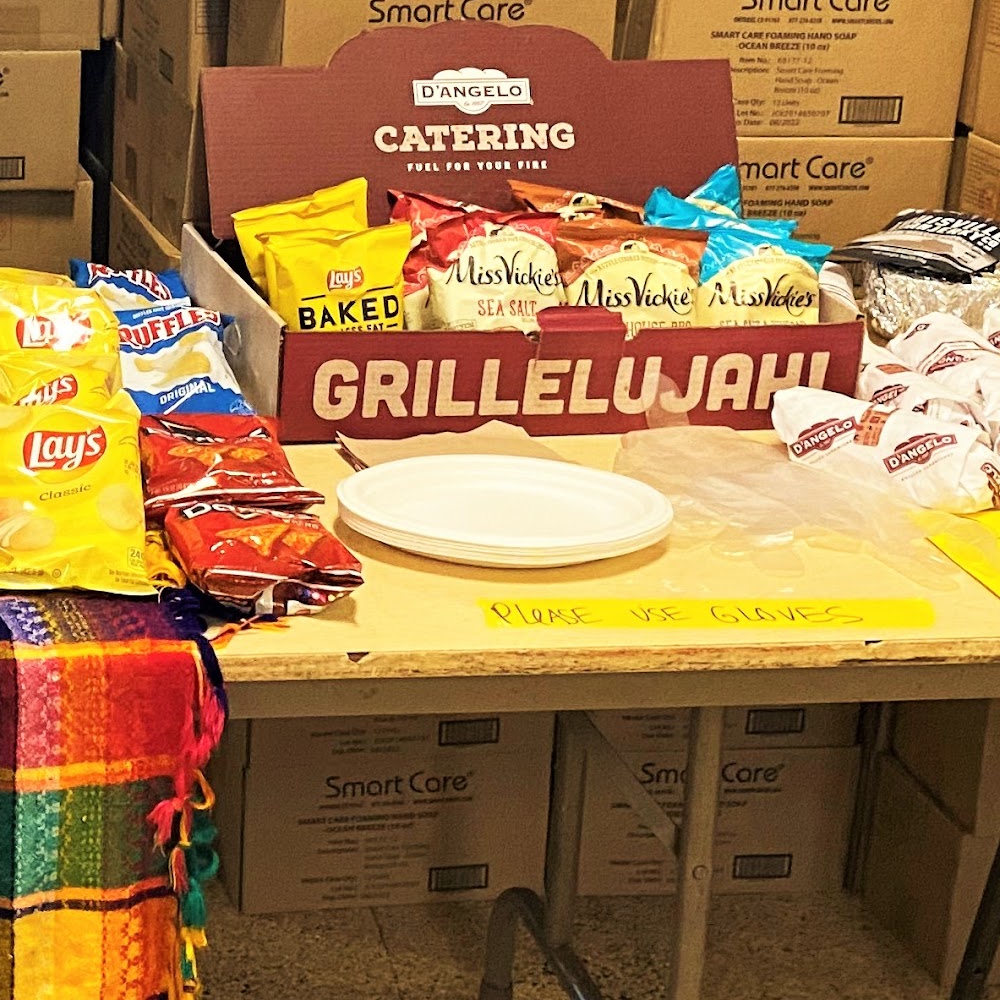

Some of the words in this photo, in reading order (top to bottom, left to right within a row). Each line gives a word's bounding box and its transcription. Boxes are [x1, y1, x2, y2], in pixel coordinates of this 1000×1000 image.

[421, 84, 523, 99] D'ANGELO
[373, 121, 576, 153] CATERING
[406, 162, 440, 172] FUEL
[446, 161, 471, 171] FOR
[476, 160, 512, 171] YOUR
[517, 160, 548, 170] FIRE
[740, 158, 800, 179] mart
[298, 294, 399, 330] BAKED
[478, 299, 504, 317] SEA
[509, 300, 537, 317] SALT
[119, 309, 220, 347] RUFFLES
[792, 419, 855, 455] D'ANGELO
[28, 430, 103, 471] Lay's
[887, 435, 953, 470] D'ANGELO
[39, 483, 92, 501] Classic
[630, 605, 691, 622] USE
[710, 604, 864, 625] GLOVES
[325, 775, 404, 799] Smart
